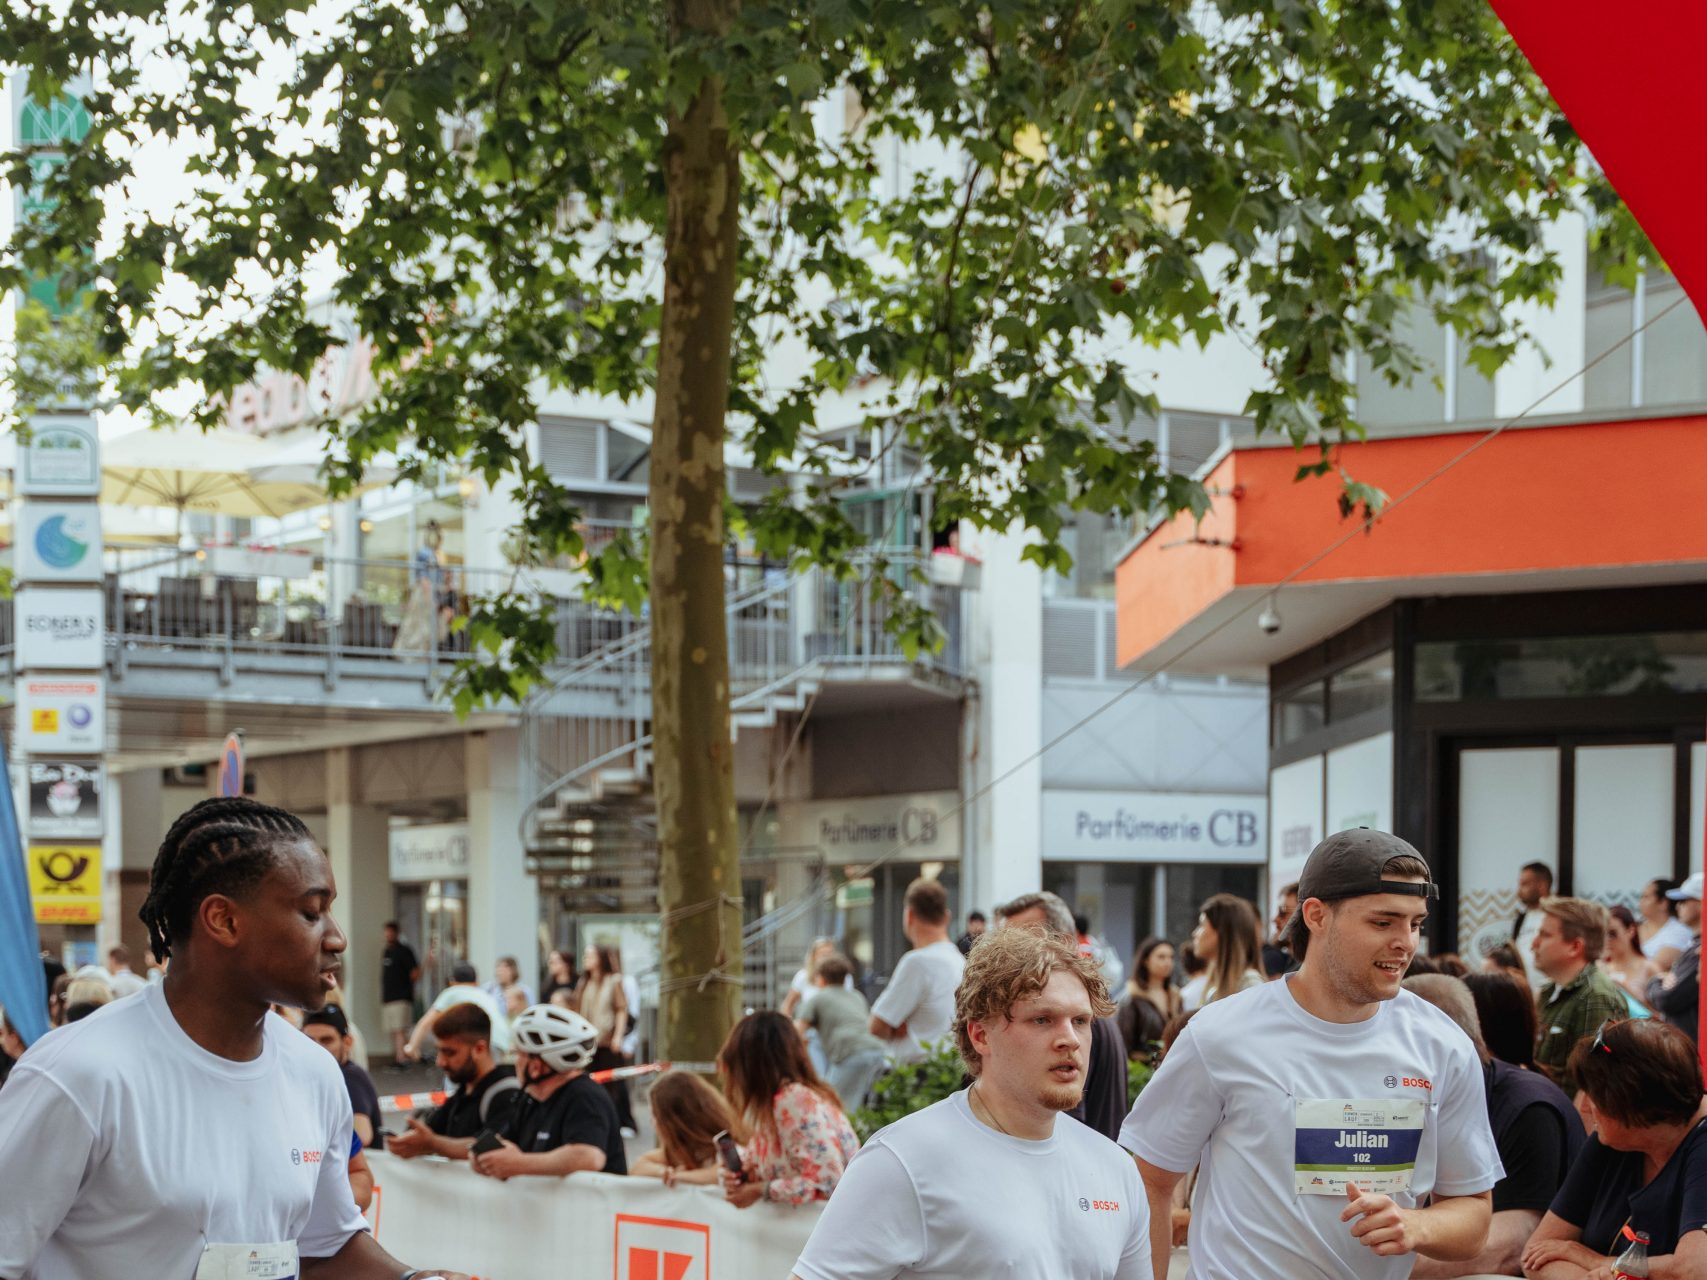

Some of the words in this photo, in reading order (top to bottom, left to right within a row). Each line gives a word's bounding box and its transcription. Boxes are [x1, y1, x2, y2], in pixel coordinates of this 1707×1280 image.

[822, 813, 898, 845] Parfümerie
[902, 807, 939, 845] CB
[1076, 808, 1201, 841] Parfümerie
[1208, 809, 1258, 847] CB
[1334, 1130, 1389, 1148] Julian
[1353, 1153, 1371, 1163] 102
[1092, 1200, 1120, 1211] BOSCH
